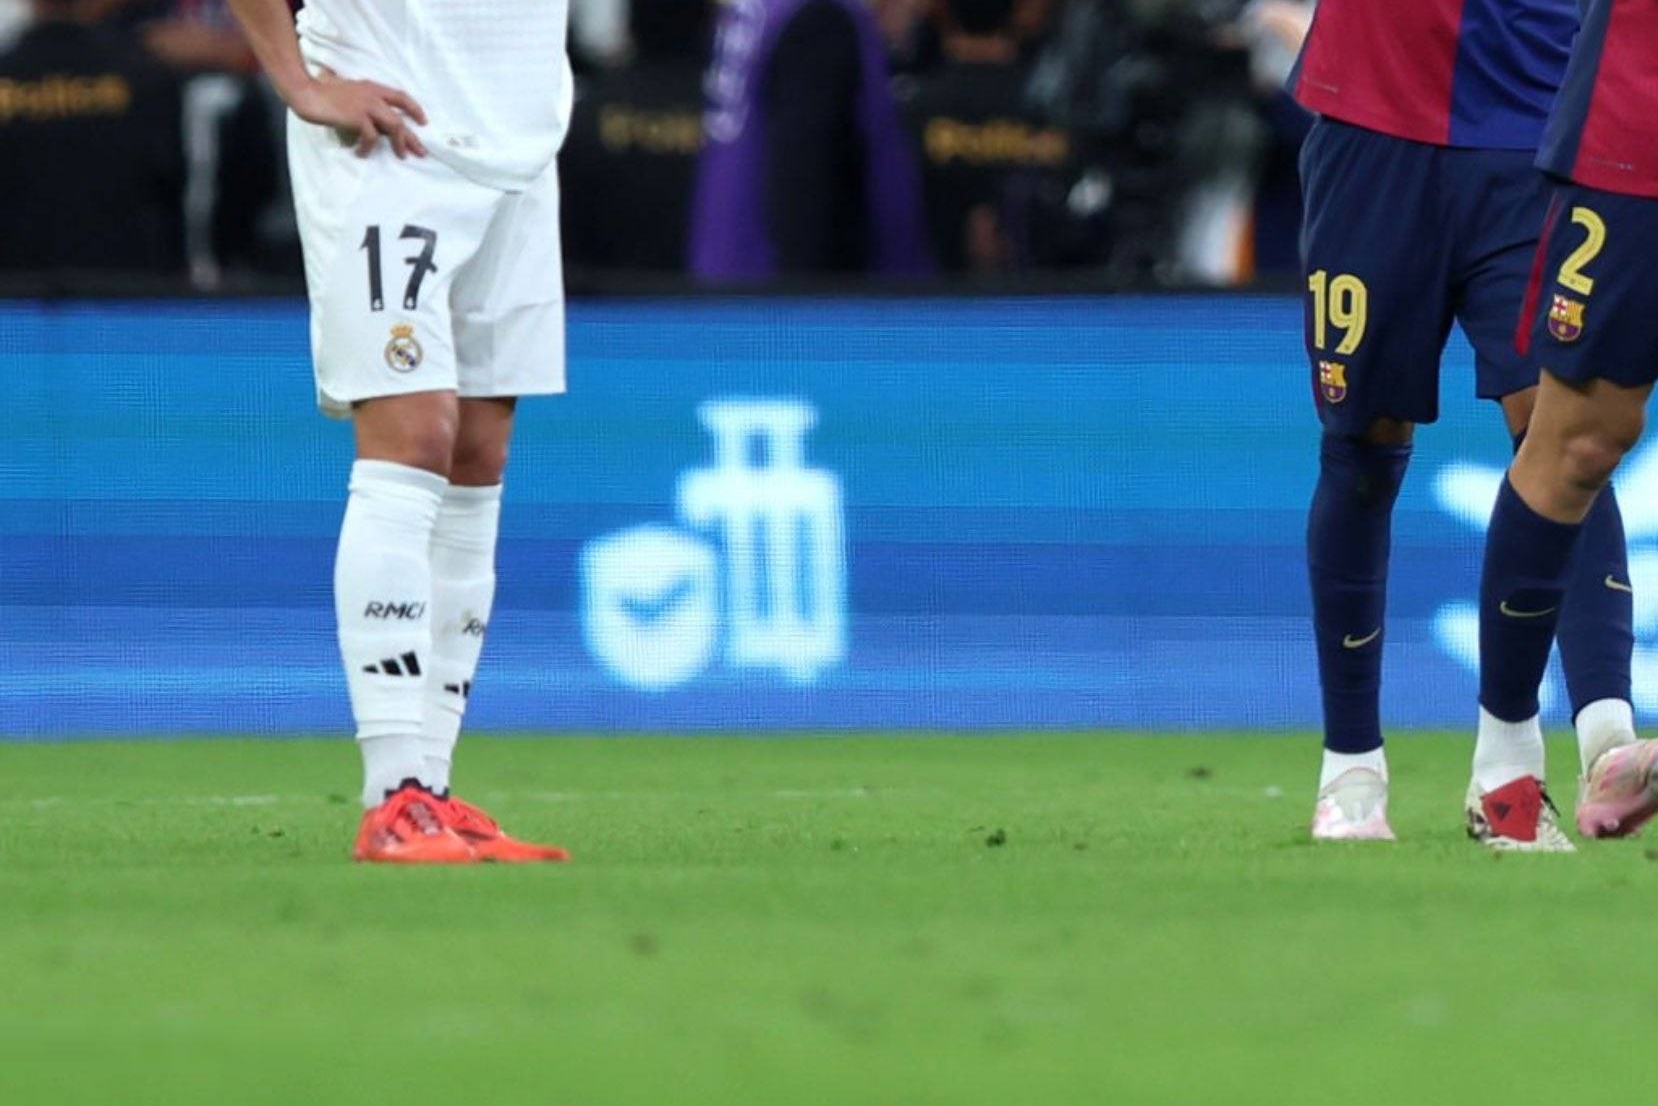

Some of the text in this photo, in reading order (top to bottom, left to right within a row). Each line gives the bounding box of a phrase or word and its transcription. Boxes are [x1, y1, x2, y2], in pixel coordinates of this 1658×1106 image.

[358, 223, 439, 312] 17
[1557, 206, 1607, 296] 2
[1308, 268, 1368, 355] 19
